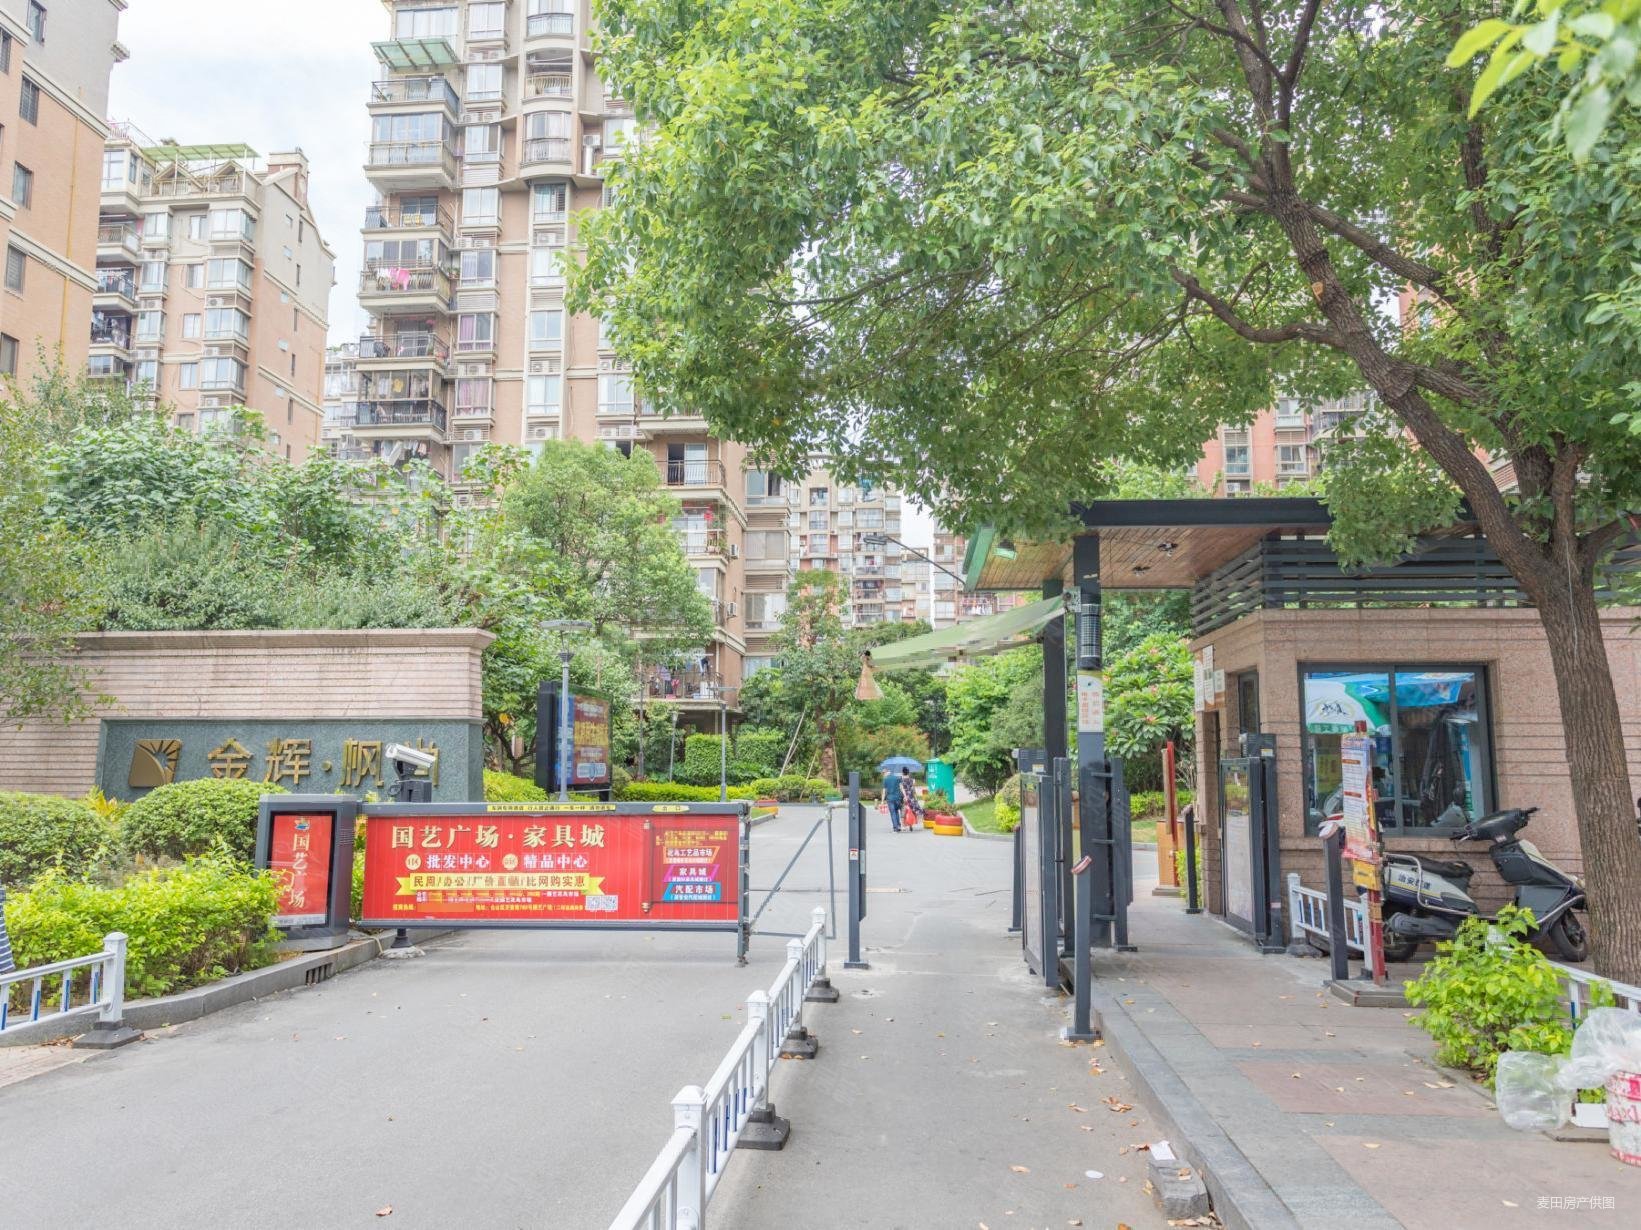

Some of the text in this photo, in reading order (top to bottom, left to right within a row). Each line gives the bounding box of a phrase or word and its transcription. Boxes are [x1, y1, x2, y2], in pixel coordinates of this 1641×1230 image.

[391, 824, 606, 849] 国艺广场·家具城
[426, 853, 490, 869] 批发中心
[523, 853, 588, 869] 精品中心
